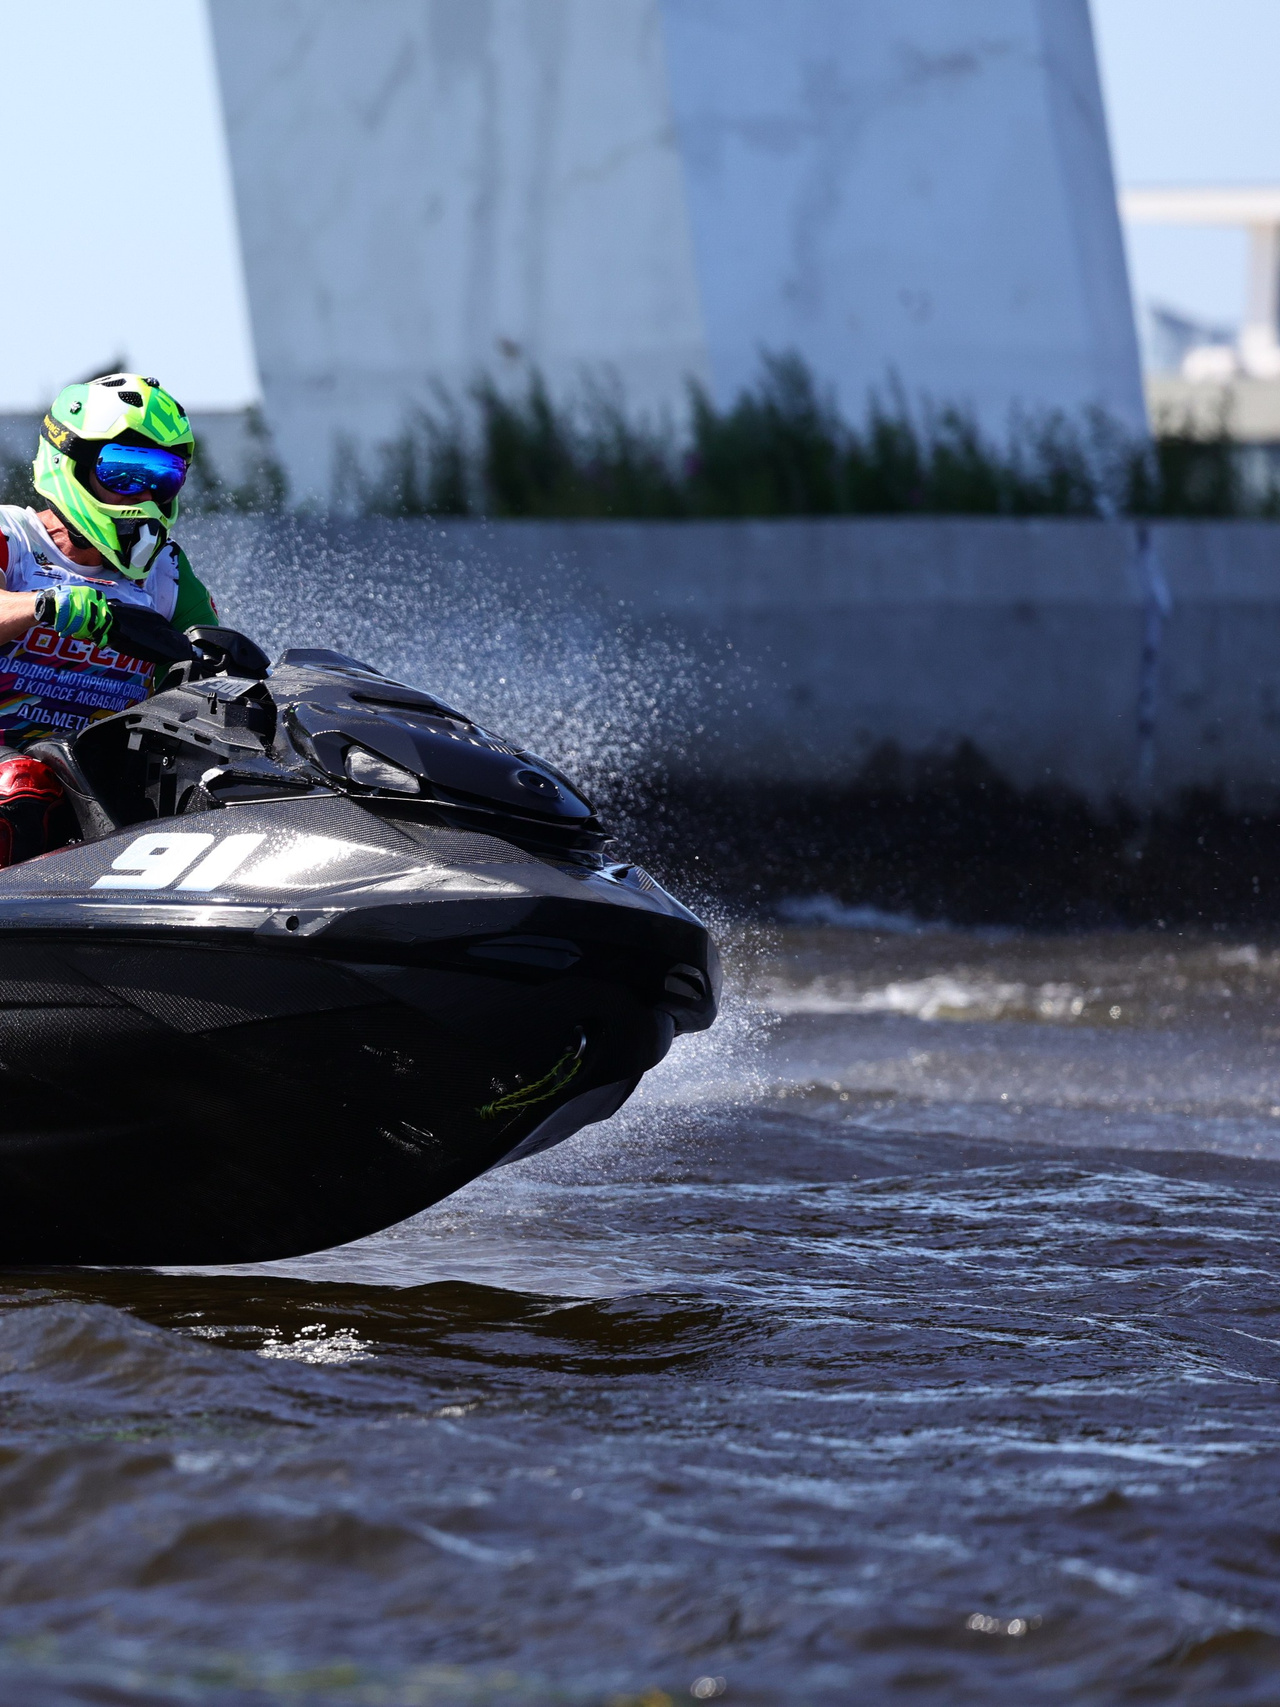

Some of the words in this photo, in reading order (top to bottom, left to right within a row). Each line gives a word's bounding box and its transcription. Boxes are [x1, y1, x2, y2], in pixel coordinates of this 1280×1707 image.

[11, 626, 156, 678] ОССИИ
[10, 660, 124, 696] ВОДНО-МОТОРНОМУ
[13, 678, 22, 690] В
[25, 681, 75, 701] КЛАССЕ
[17, 704, 96, 730] АЛЬМЕТЬ
[90, 832, 267, 892] 91
